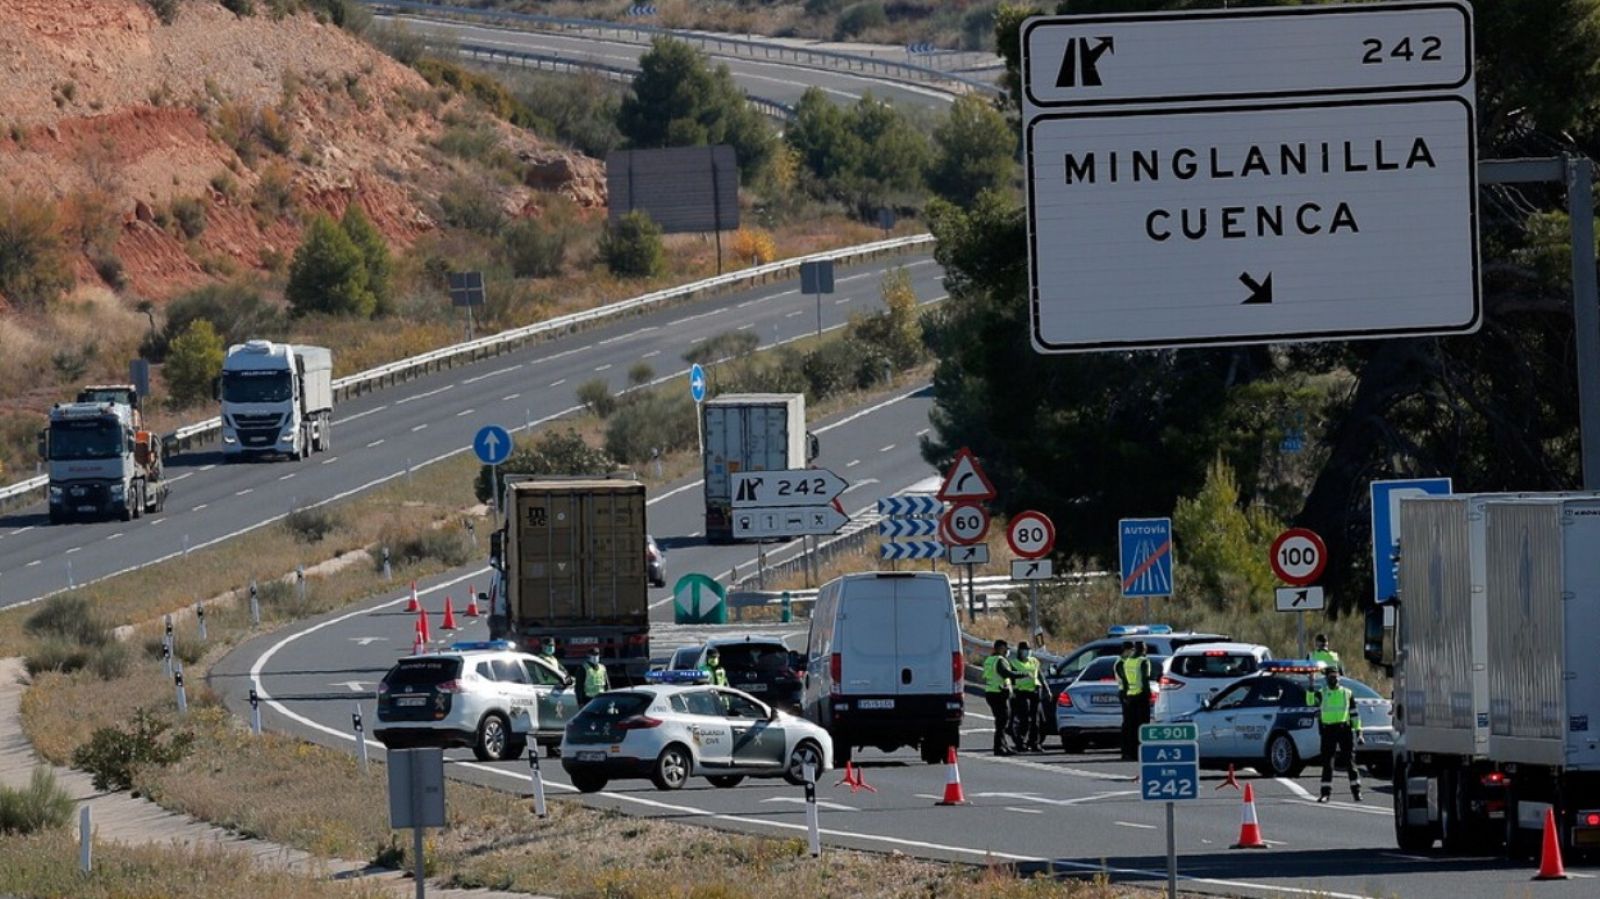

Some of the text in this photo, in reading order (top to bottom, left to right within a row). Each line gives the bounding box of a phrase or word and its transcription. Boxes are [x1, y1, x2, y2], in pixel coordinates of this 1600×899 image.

[1361, 36, 1443, 64] 242
[1064, 136, 1437, 185] MINGLANILLA
[1145, 201, 1360, 241] CUENCA
[777, 478, 827, 496] 242
[955, 515, 980, 531] 60
[1124, 524, 1167, 535] AUTOVÍA
[1018, 527, 1043, 543] 80
[1281, 547, 1316, 566] 100
[1148, 727, 1188, 740] E-901
[1156, 748, 1182, 761] A-3
[1160, 768, 1178, 777] km
[1147, 778, 1193, 797] 242
